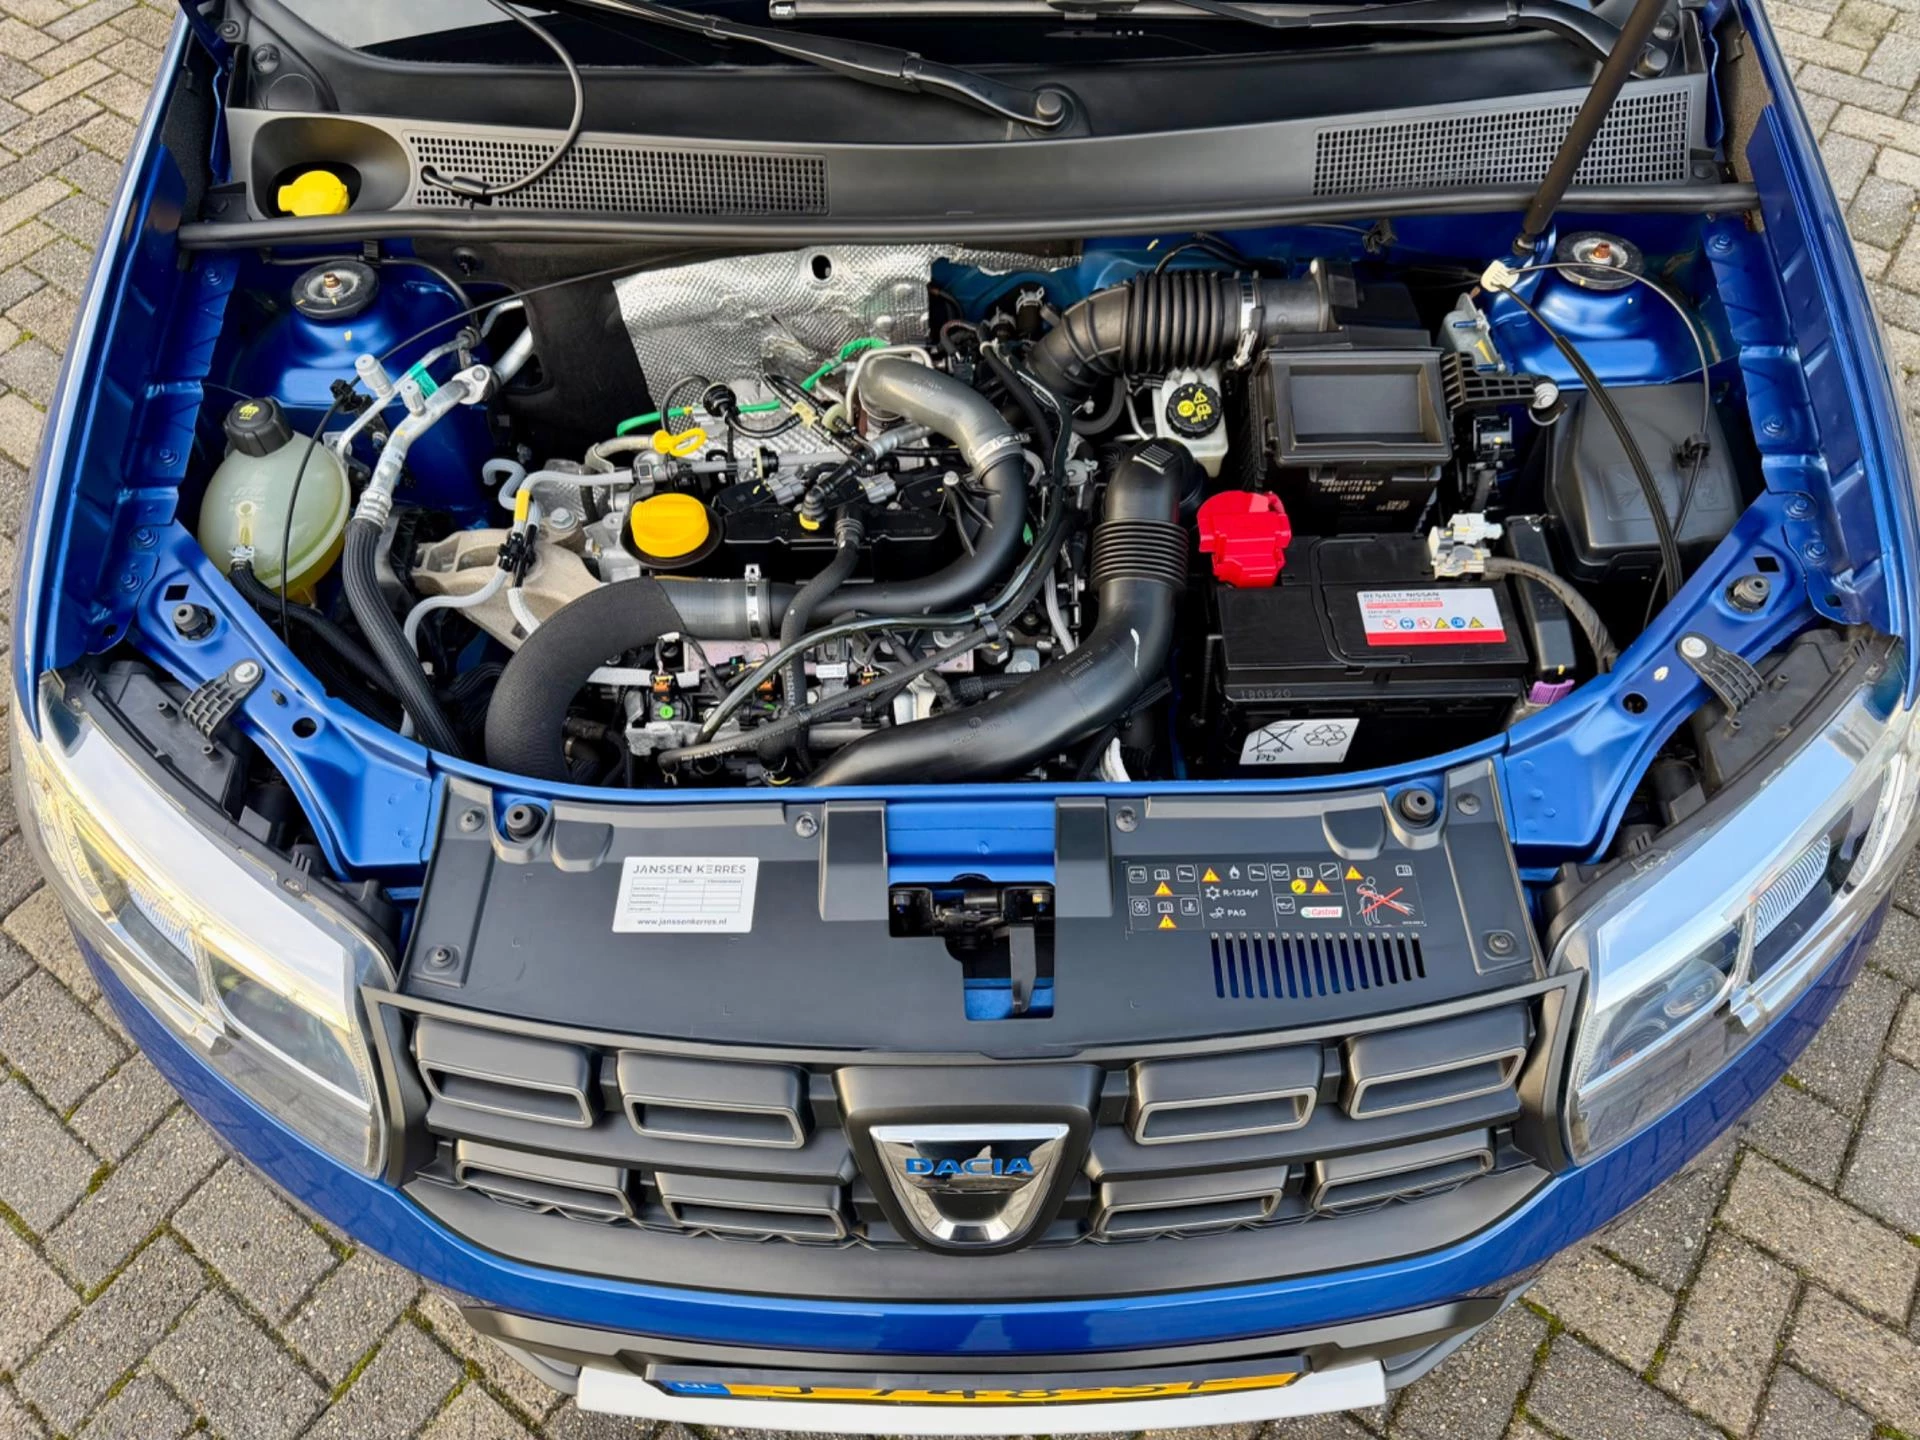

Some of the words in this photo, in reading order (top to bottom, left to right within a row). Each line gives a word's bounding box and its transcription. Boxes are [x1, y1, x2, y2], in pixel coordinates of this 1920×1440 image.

[1256, 754, 1276, 762] Pb
[633, 864, 692, 874] JANSSEN
[697, 864, 747, 874] KERRES
[1223, 889, 1259, 898] R-1234yf
[1311, 907, 1339, 916] Castrol
[637, 917, 727, 926] www.janssenkerres.nl
[905, 1158, 1034, 1176] DACIA
